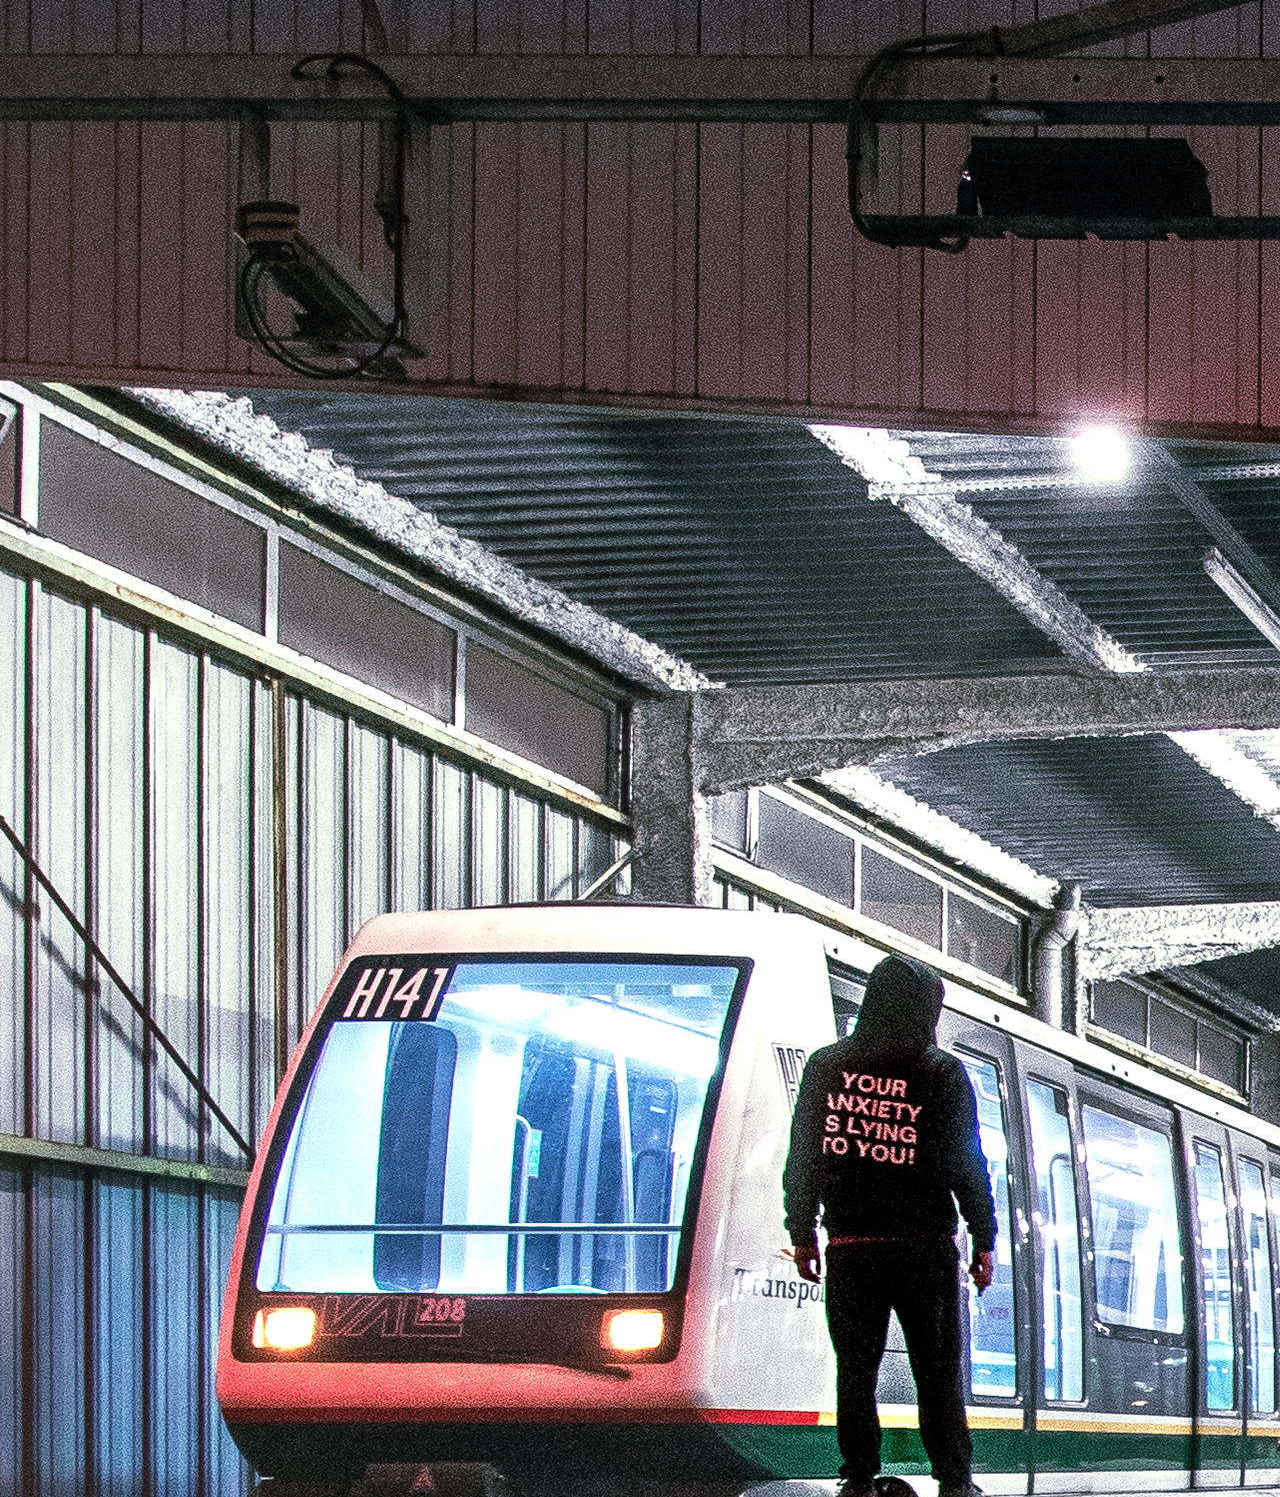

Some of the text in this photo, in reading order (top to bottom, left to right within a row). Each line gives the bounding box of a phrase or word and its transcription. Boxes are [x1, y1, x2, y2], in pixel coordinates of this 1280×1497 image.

[343, 967, 449, 1018] H141
[842, 1070, 908, 1098] YOUR
[824, 1114, 918, 1145] S LYING
[855, 1139, 916, 1165] YOU!
[420, 1297, 467, 1322] 208
